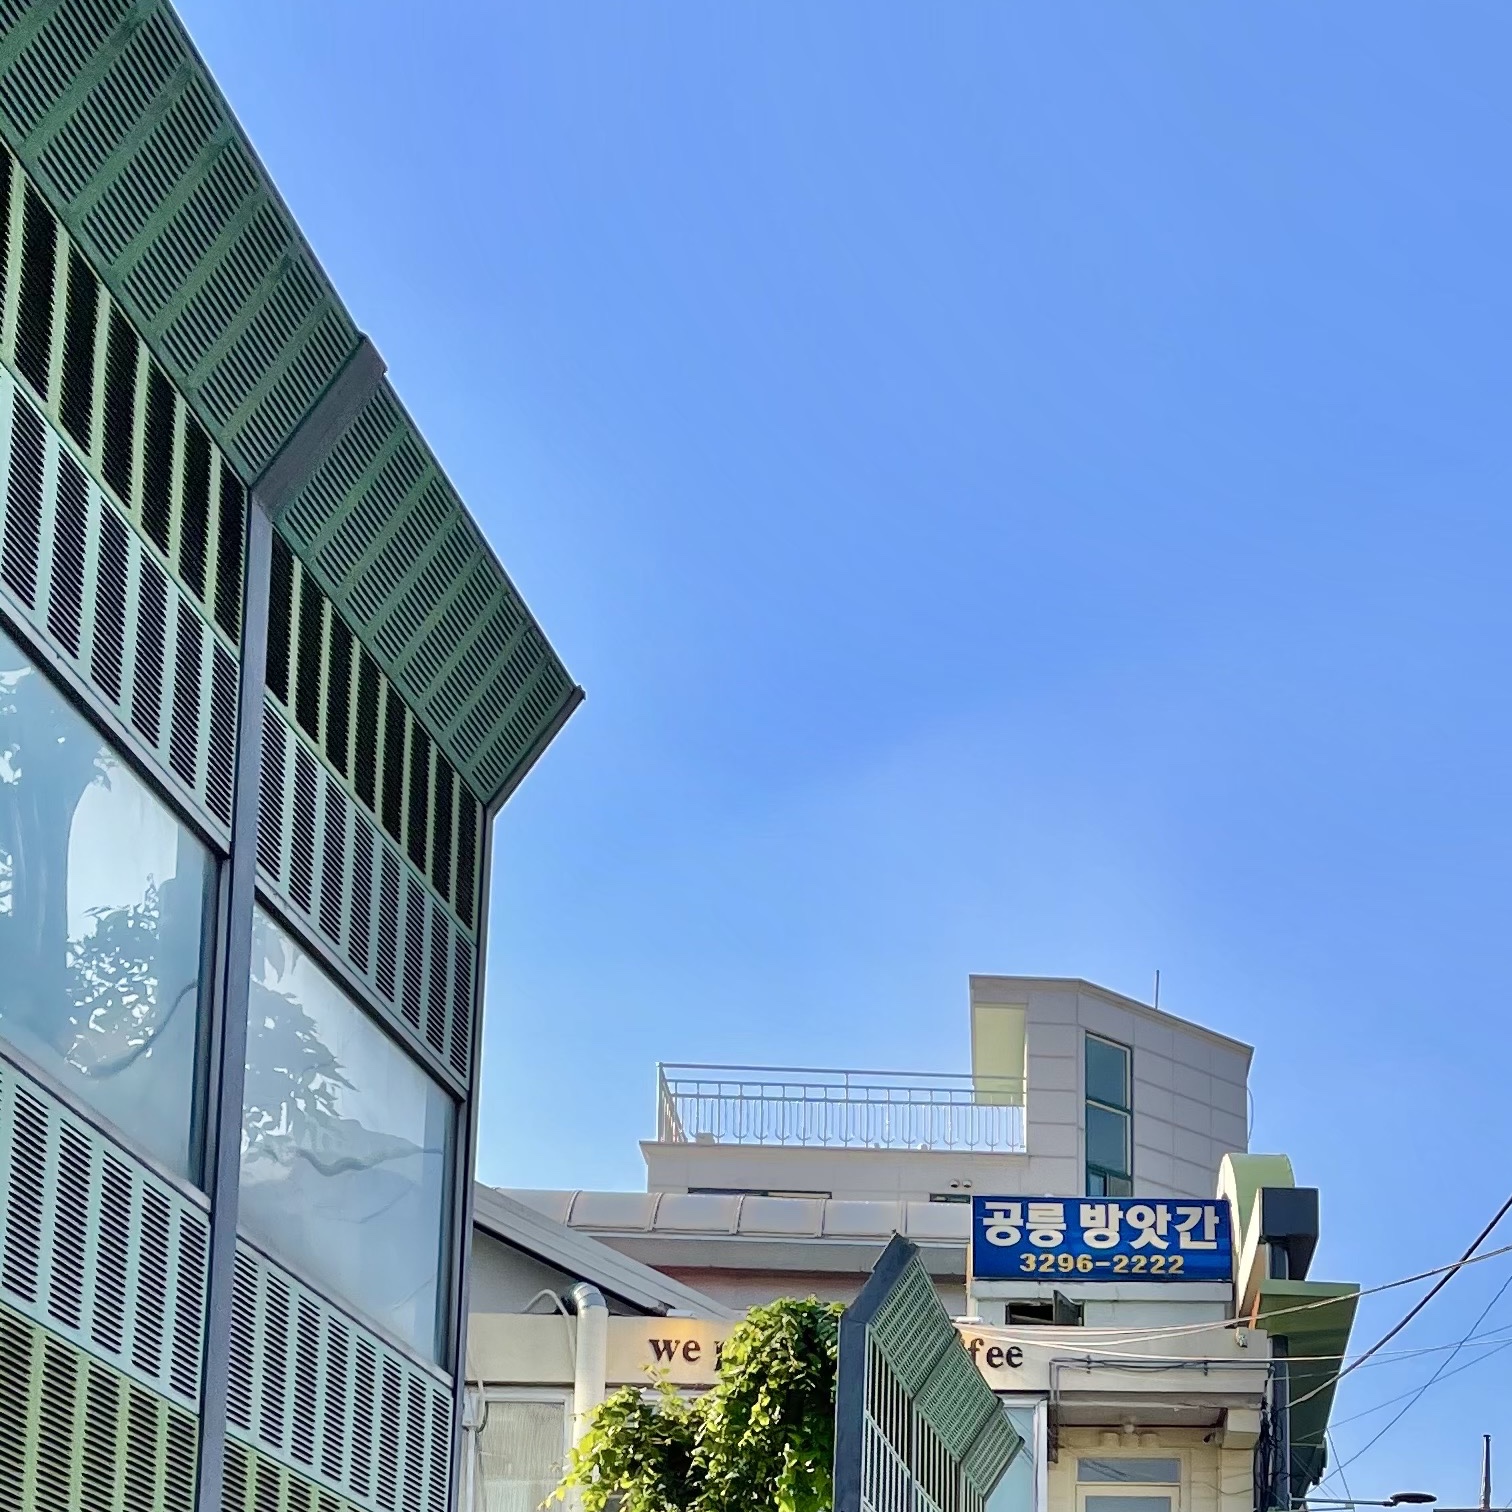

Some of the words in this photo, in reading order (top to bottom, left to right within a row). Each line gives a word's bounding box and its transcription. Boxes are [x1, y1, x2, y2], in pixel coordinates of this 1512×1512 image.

[983, 1202, 1067, 1248] 공릉
[1080, 1203, 1220, 1250] 방앗간
[1019, 1253, 1185, 1274] 3296-2222
[649, 1339, 701, 1362] we
[967, 1338, 1024, 1368] fee
